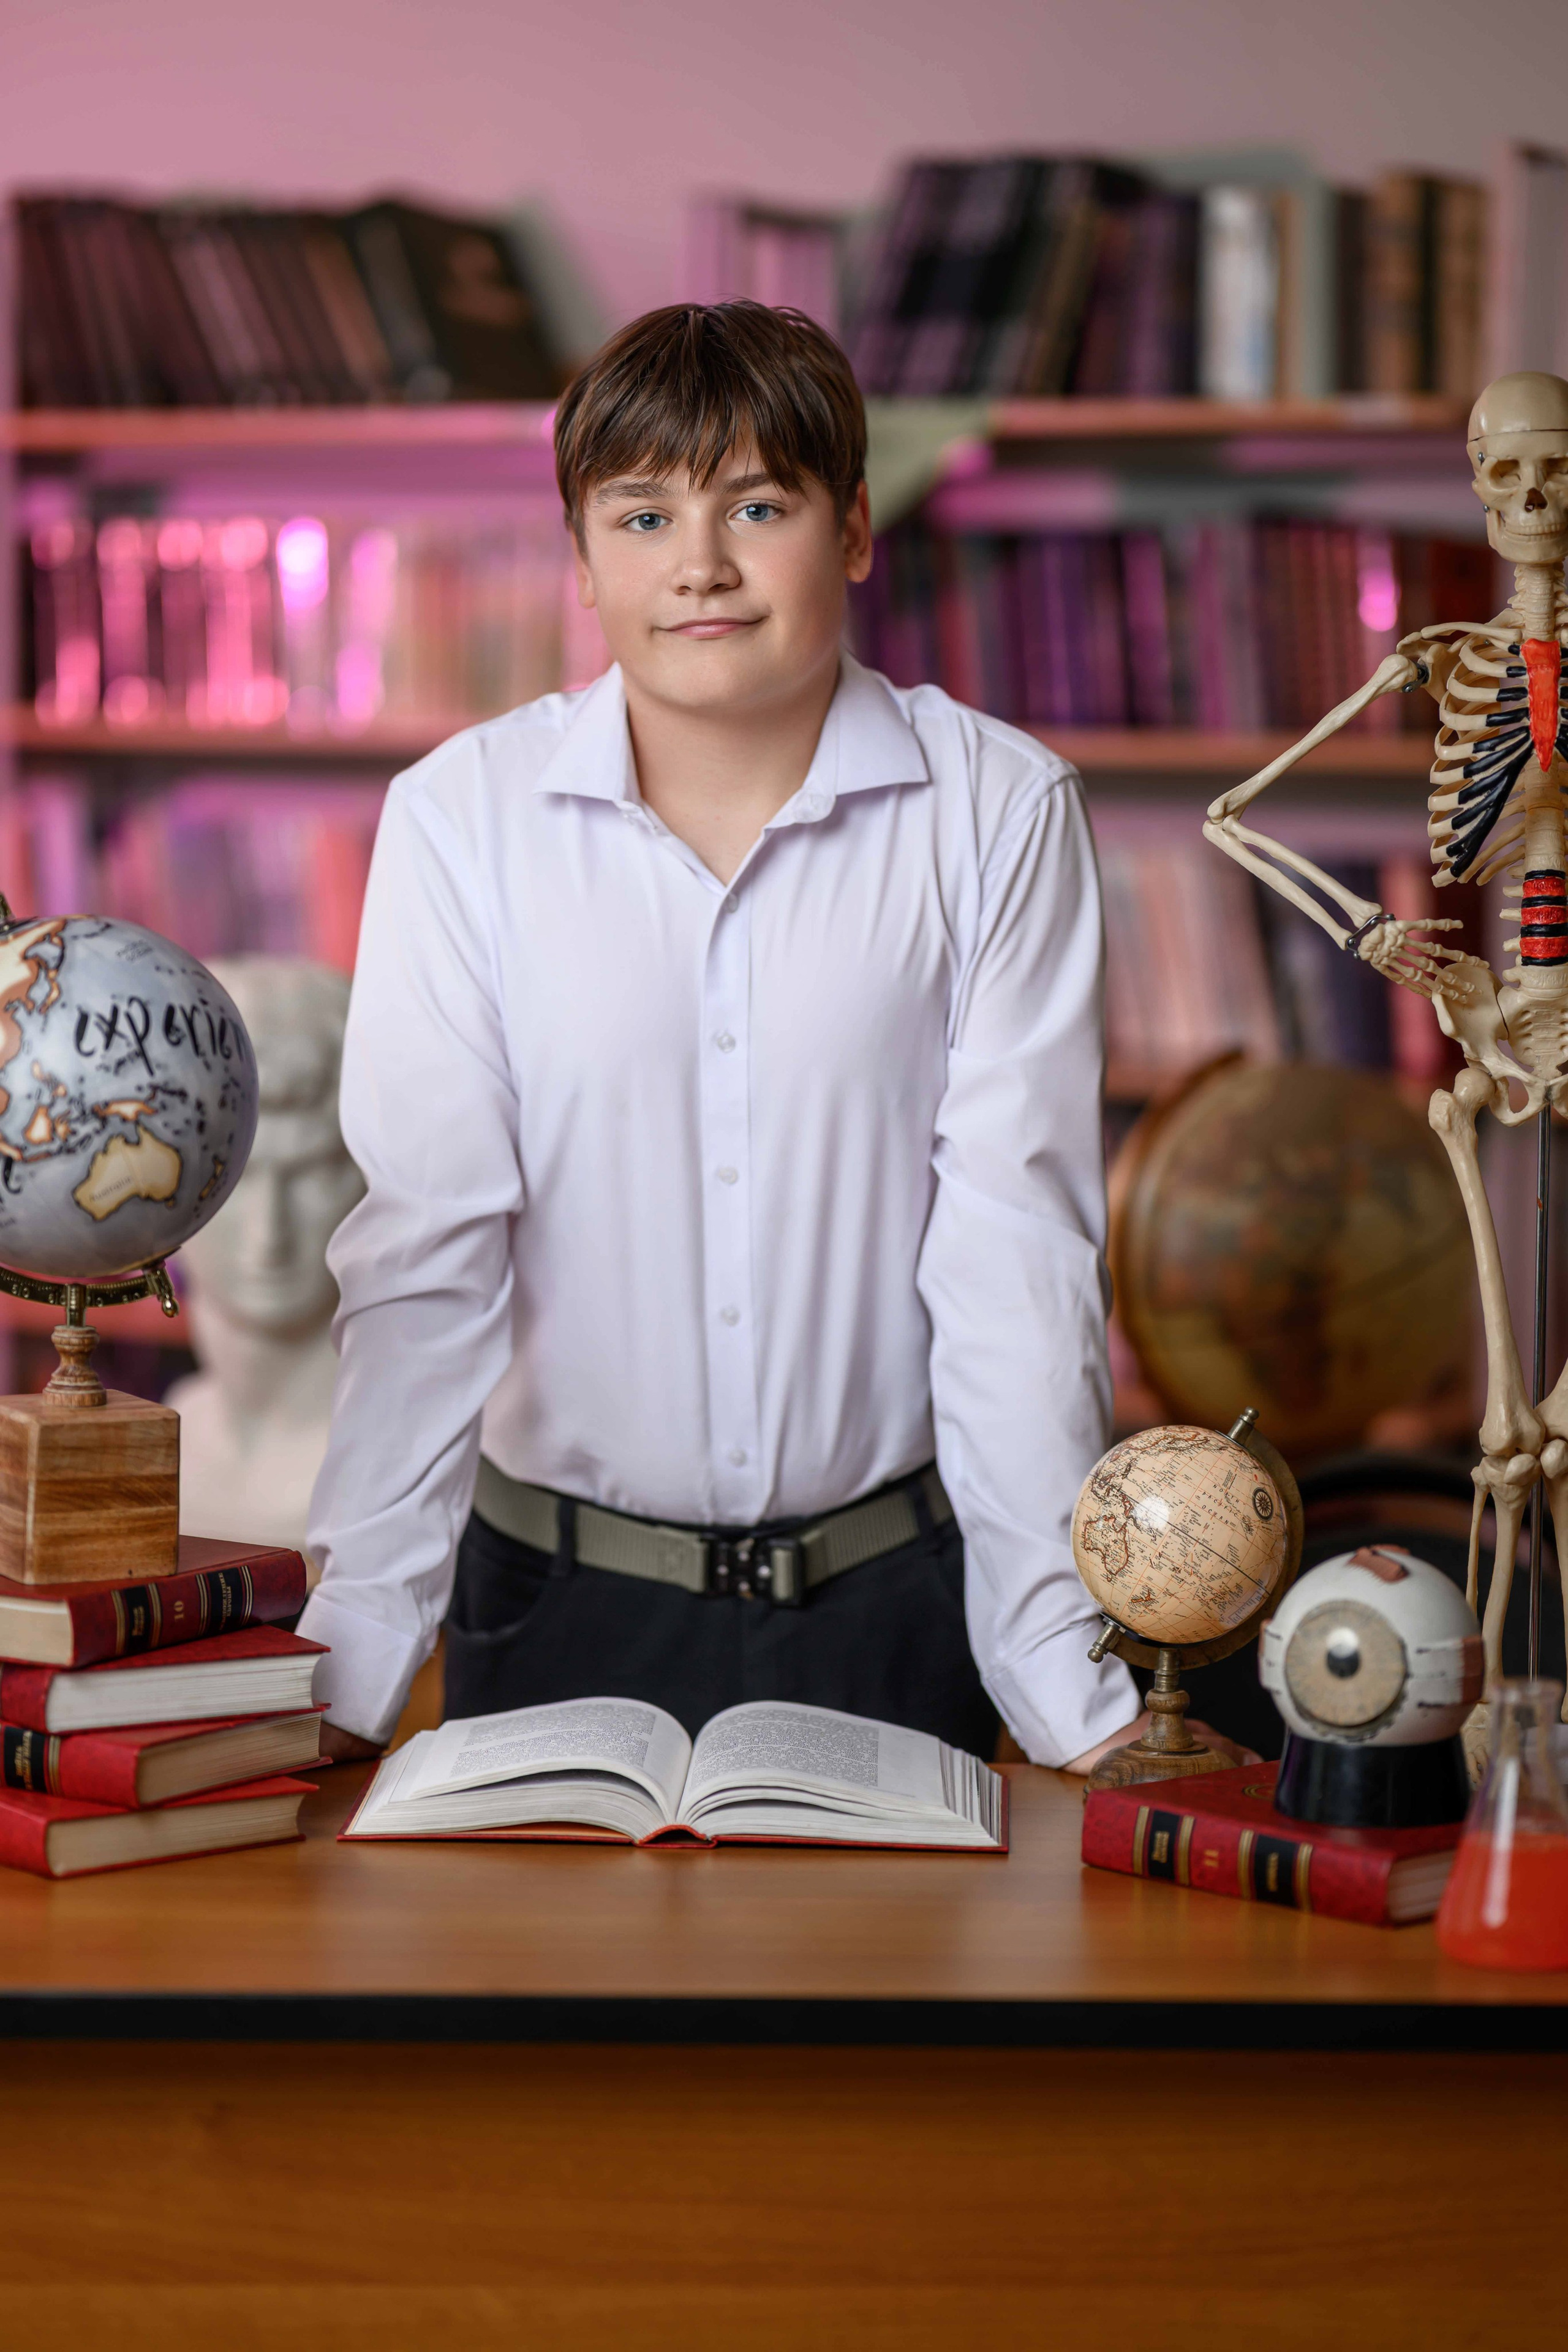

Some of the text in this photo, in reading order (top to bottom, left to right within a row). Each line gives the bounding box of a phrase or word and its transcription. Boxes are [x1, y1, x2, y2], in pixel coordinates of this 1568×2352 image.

[1202, 1491, 1238, 1517] PACIFIC
[1213, 1483, 1240, 1504] NORTH
[1202, 1504, 1229, 1525] OCEAN
[174, 1600, 184, 1620] 10
